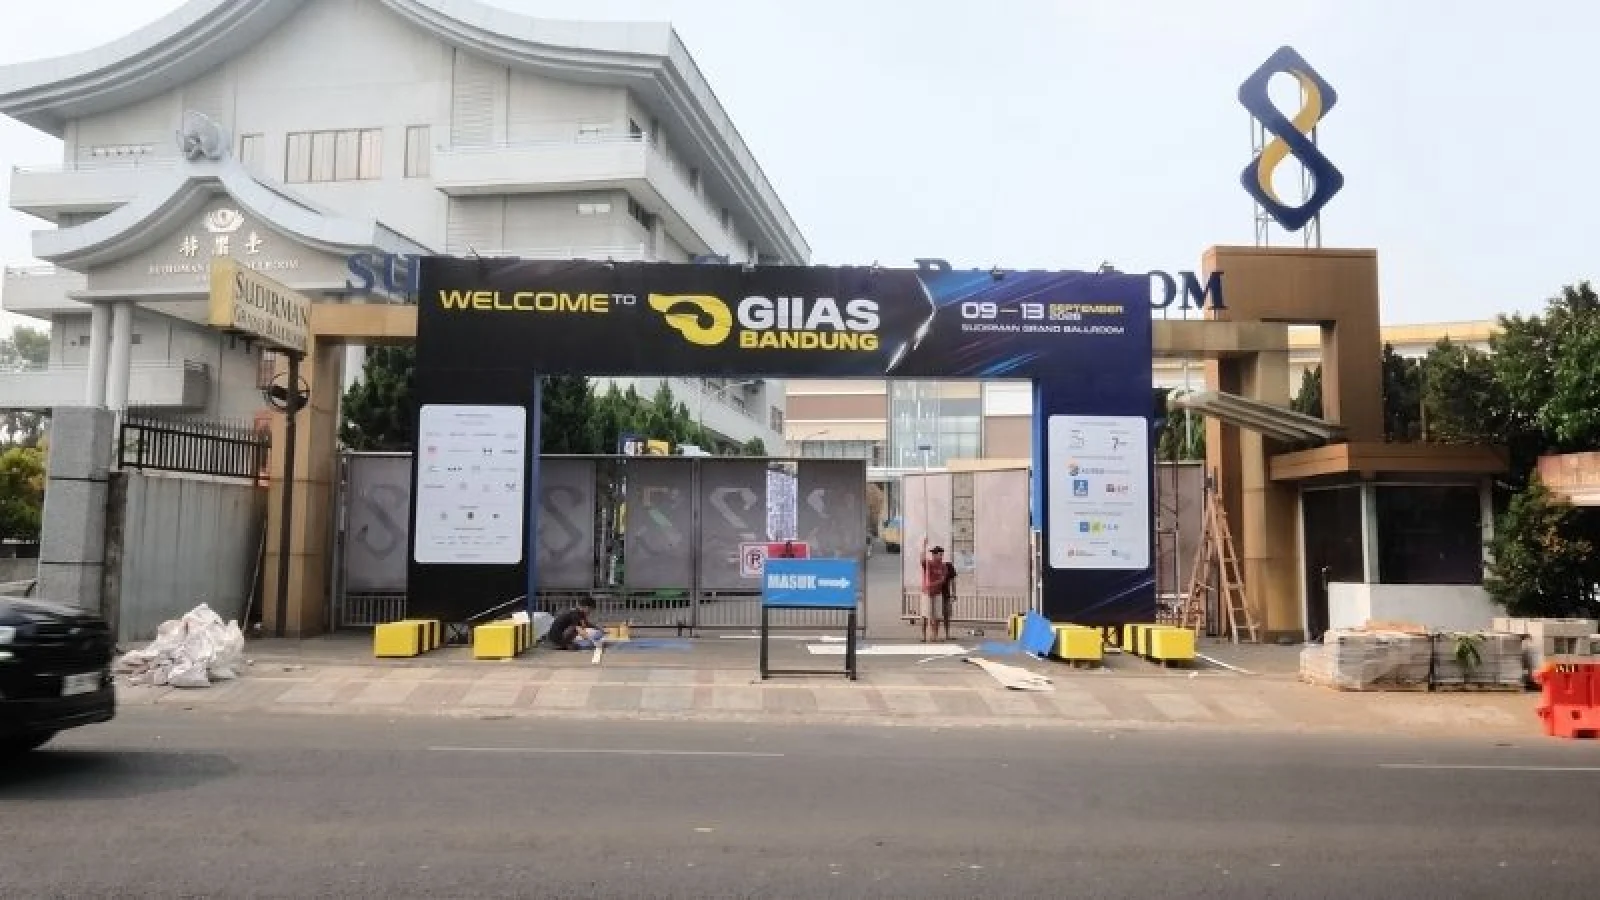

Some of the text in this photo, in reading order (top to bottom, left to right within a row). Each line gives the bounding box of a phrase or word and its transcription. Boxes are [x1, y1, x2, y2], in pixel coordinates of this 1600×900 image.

[236, 271, 307, 324] SUDIRMAN
[439, 289, 637, 313] WELCOME TO
[737, 295, 881, 331] GIIAS
[961, 301, 997, 319] 09
[1021, 303, 1045, 319] 13
[1050, 304, 1124, 314] SEPTEMBER
[961, 323, 1125, 335] SUDIRMAN GRAND BALLROOM
[739, 330, 880, 351] BANDUNG
[768, 573, 817, 591] MASUK
